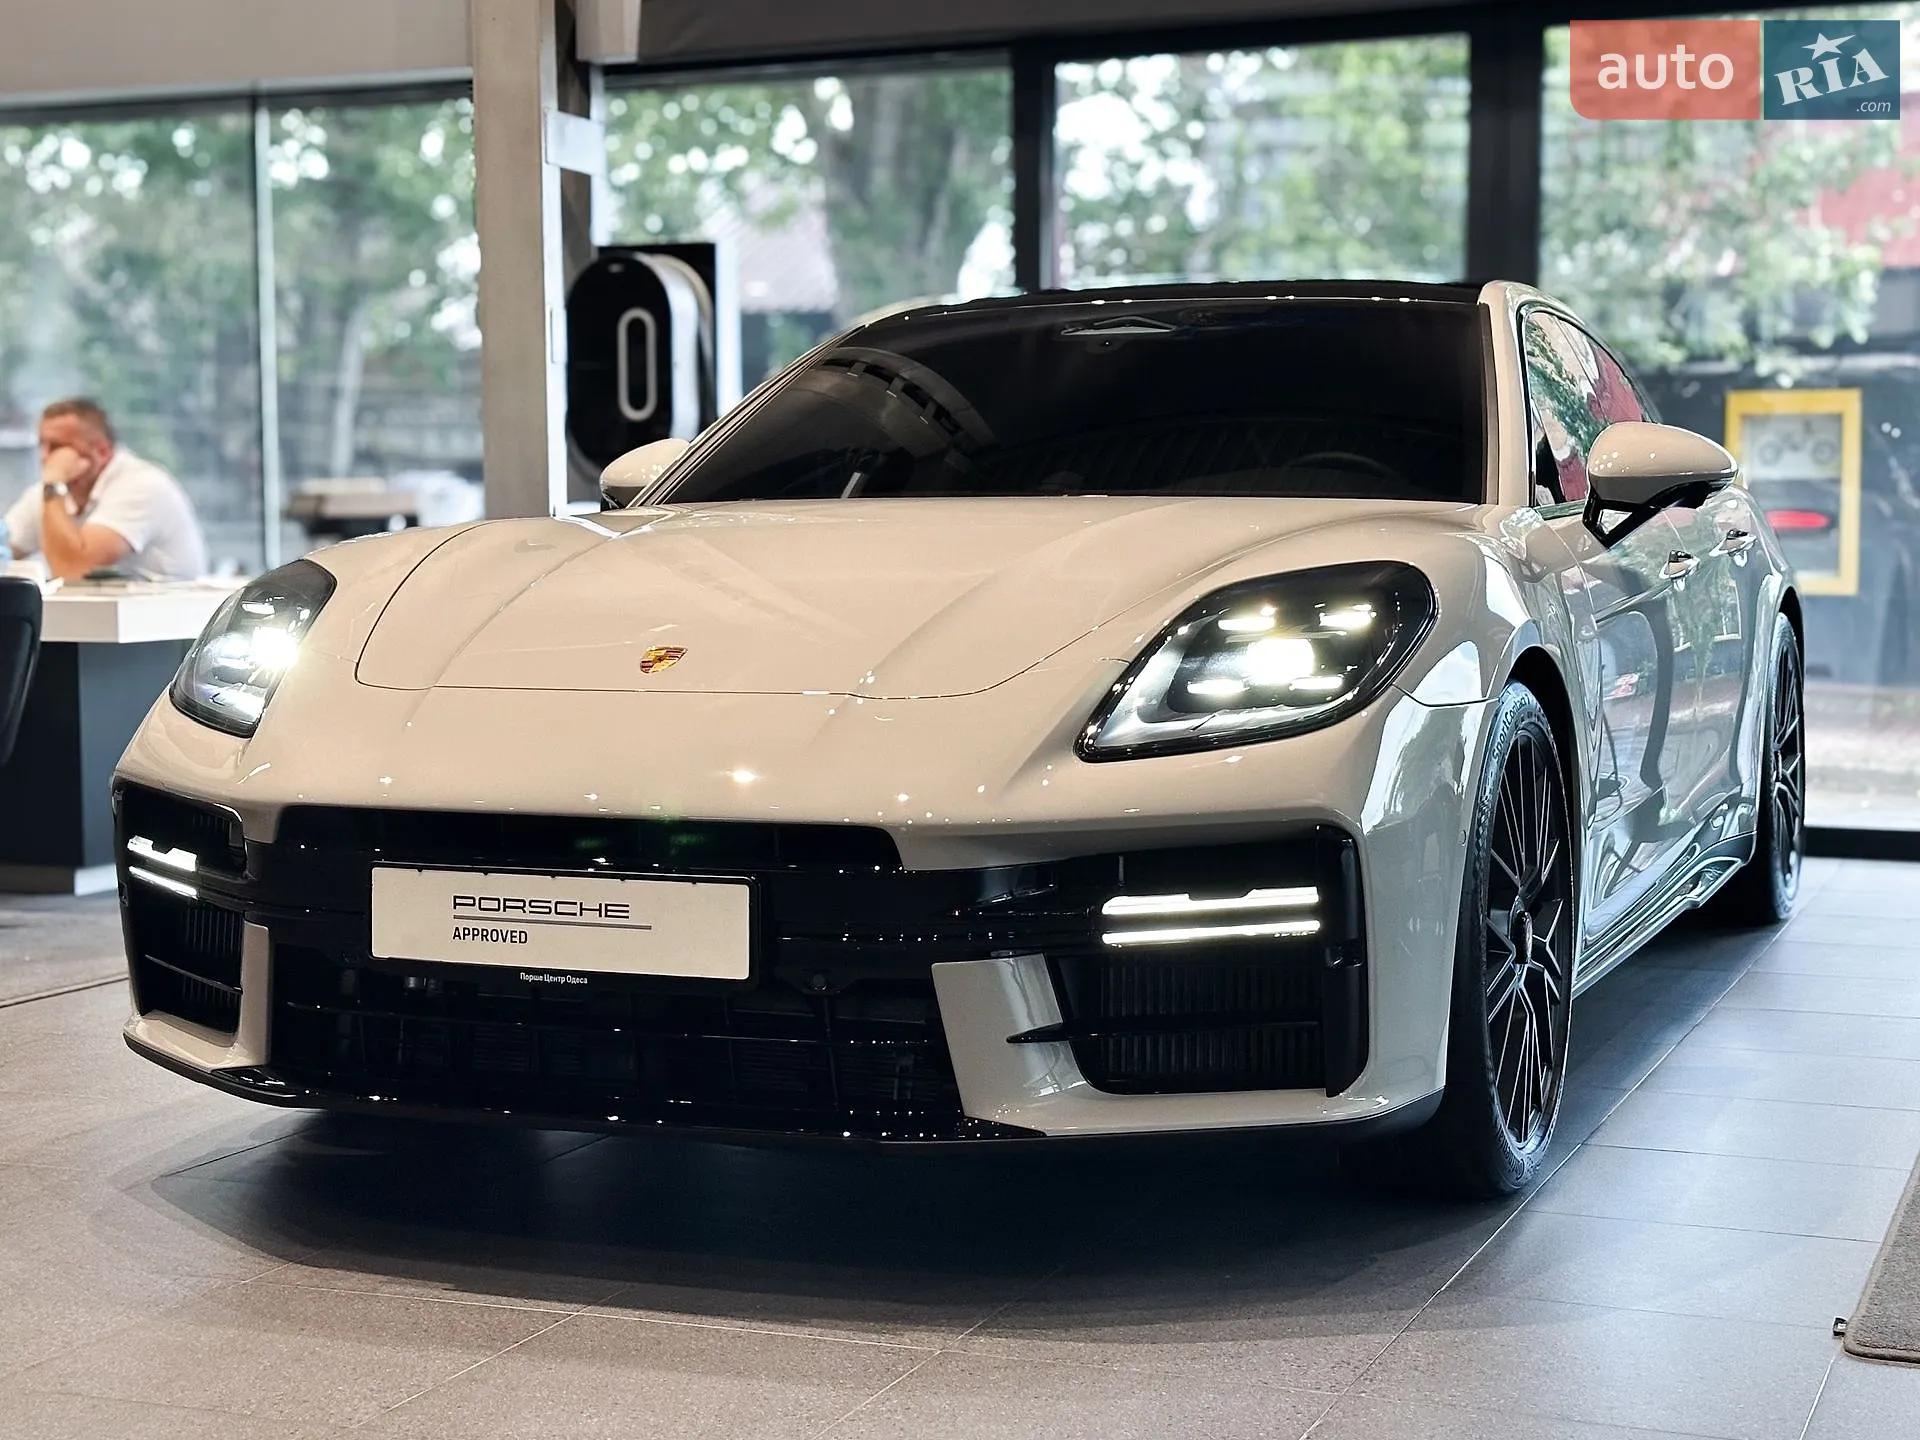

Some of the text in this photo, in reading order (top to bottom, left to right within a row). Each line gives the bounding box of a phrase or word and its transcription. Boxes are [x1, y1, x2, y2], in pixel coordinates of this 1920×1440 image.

[453, 895, 630, 920] PORSCHE
[453, 926, 528, 944] APPROVED
[520, 972, 588, 985] Порше Центр Одеса
